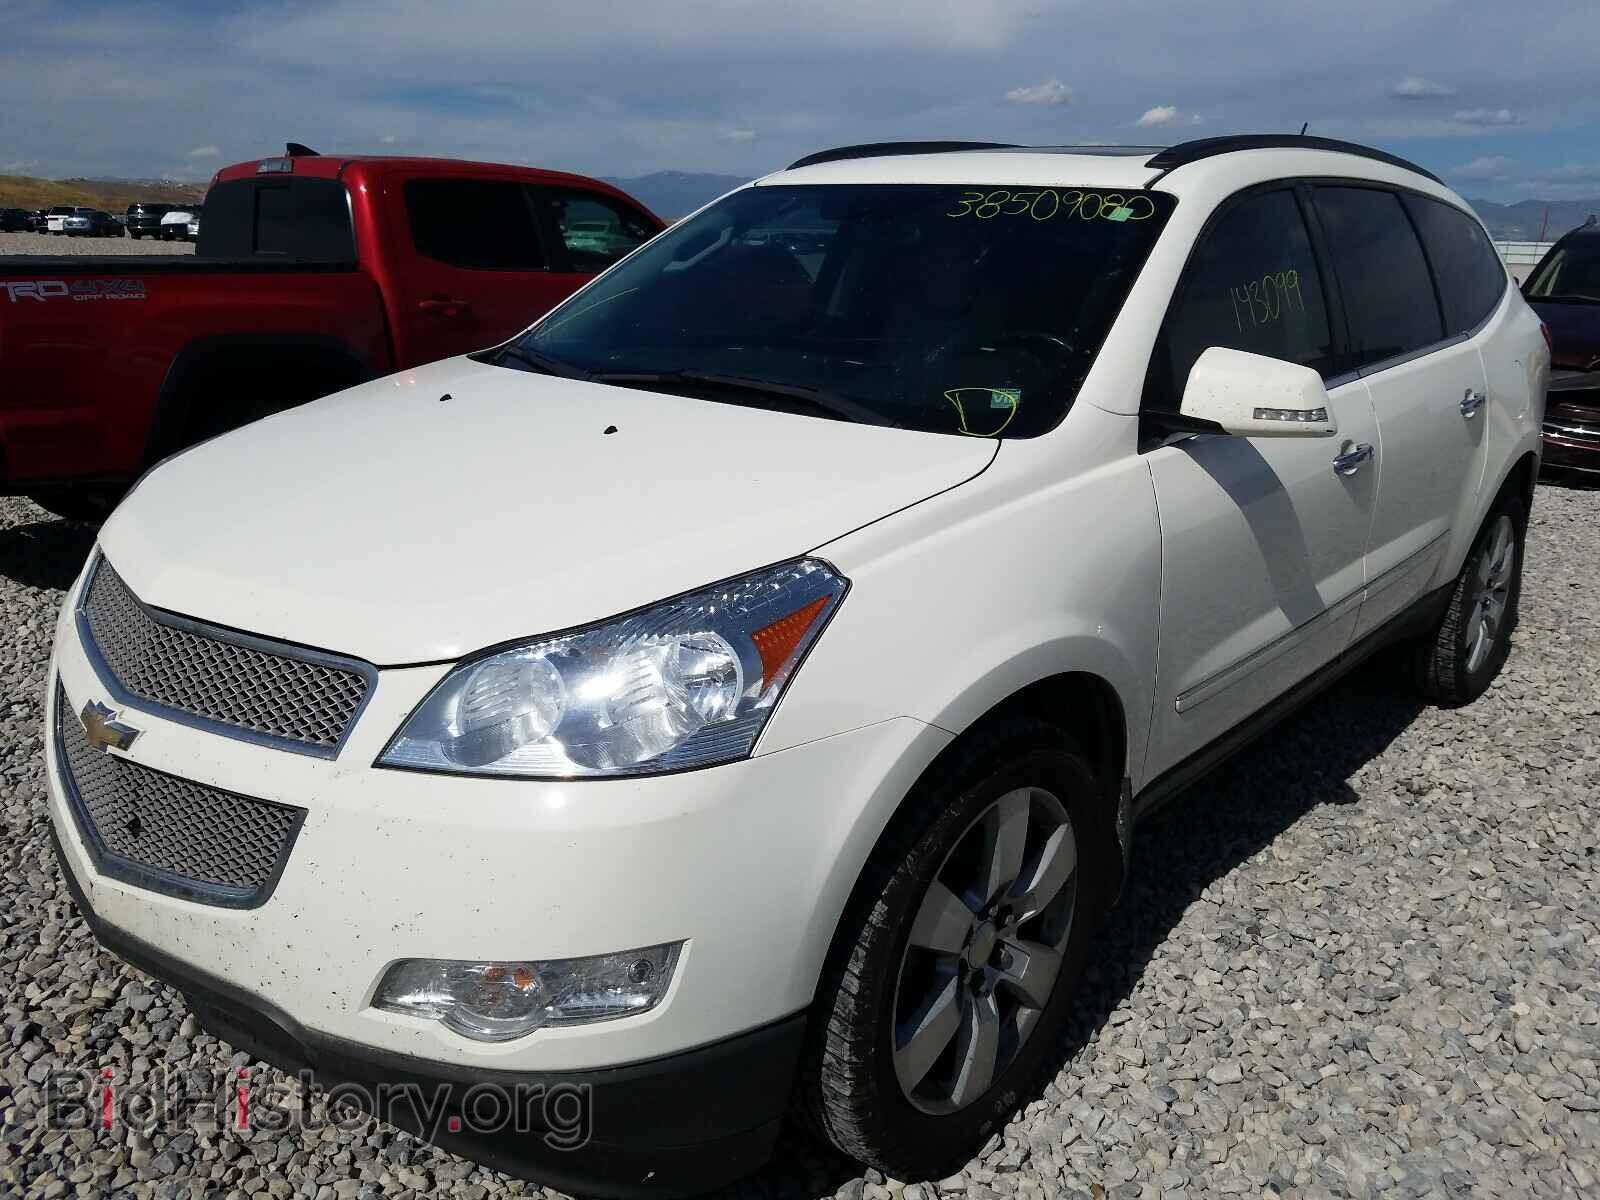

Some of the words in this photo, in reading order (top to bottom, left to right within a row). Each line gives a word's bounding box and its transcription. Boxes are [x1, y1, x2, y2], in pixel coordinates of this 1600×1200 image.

[946, 189, 1155, 221] 38509080
[0, 280, 69, 302] TRD
[1230, 269, 1304, 333] 143099
